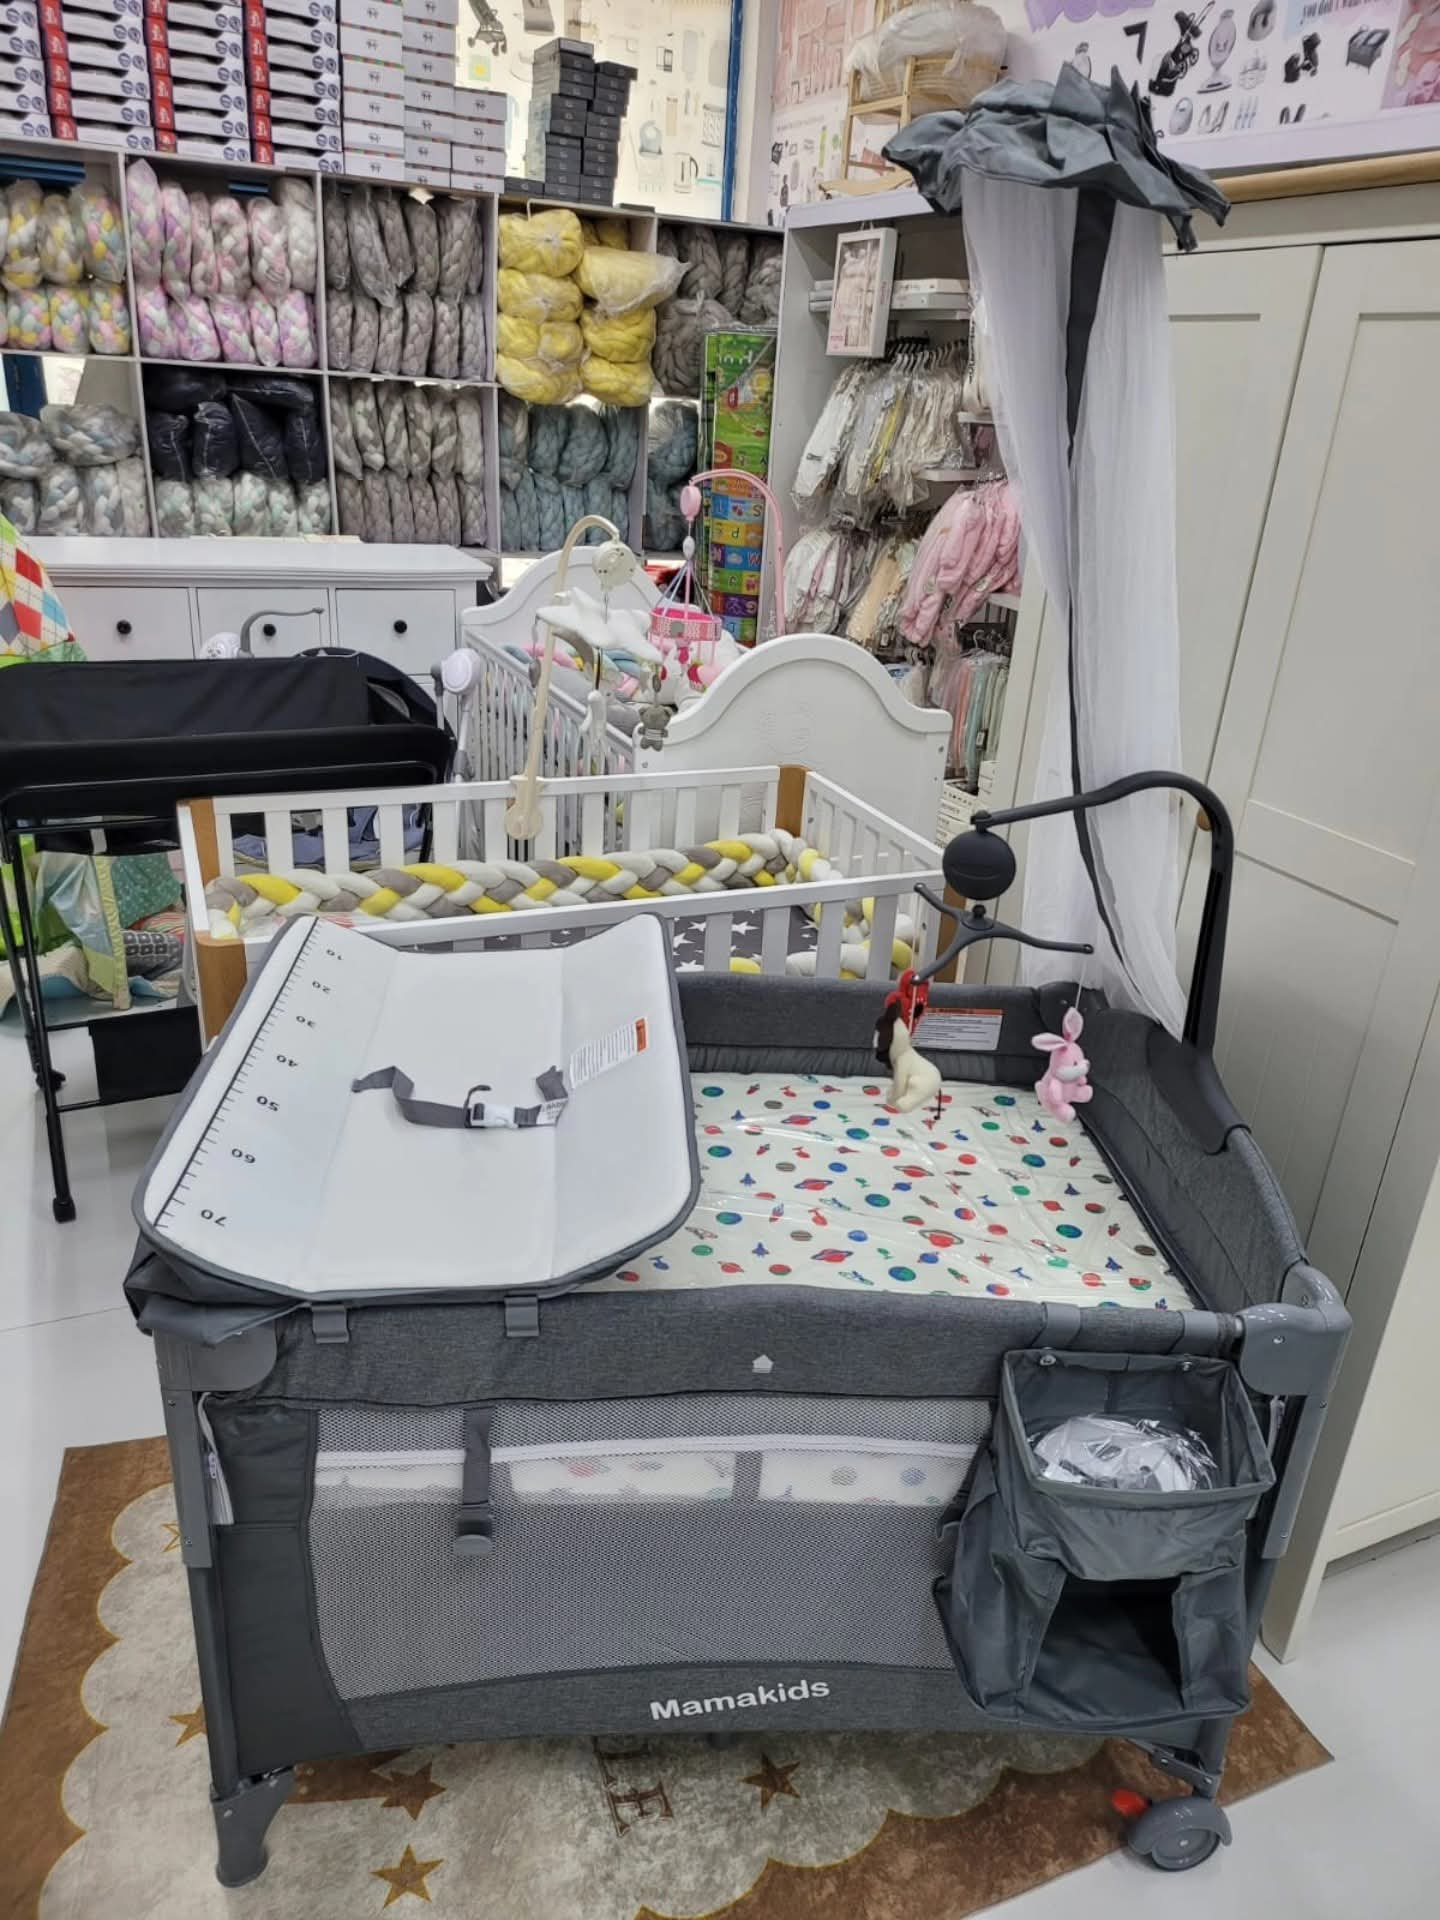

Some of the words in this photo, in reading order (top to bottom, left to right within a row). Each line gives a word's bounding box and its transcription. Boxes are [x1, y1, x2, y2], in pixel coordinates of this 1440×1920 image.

[312, 981, 331, 994] 20
[296, 1015, 316, 1028] 30
[276, 1054, 299, 1068] 40
[256, 1095, 279, 1112] 50
[231, 1148, 256, 1164] 60
[200, 1209, 227, 1227] 70
[650, 1679, 830, 1720] Mamakids
